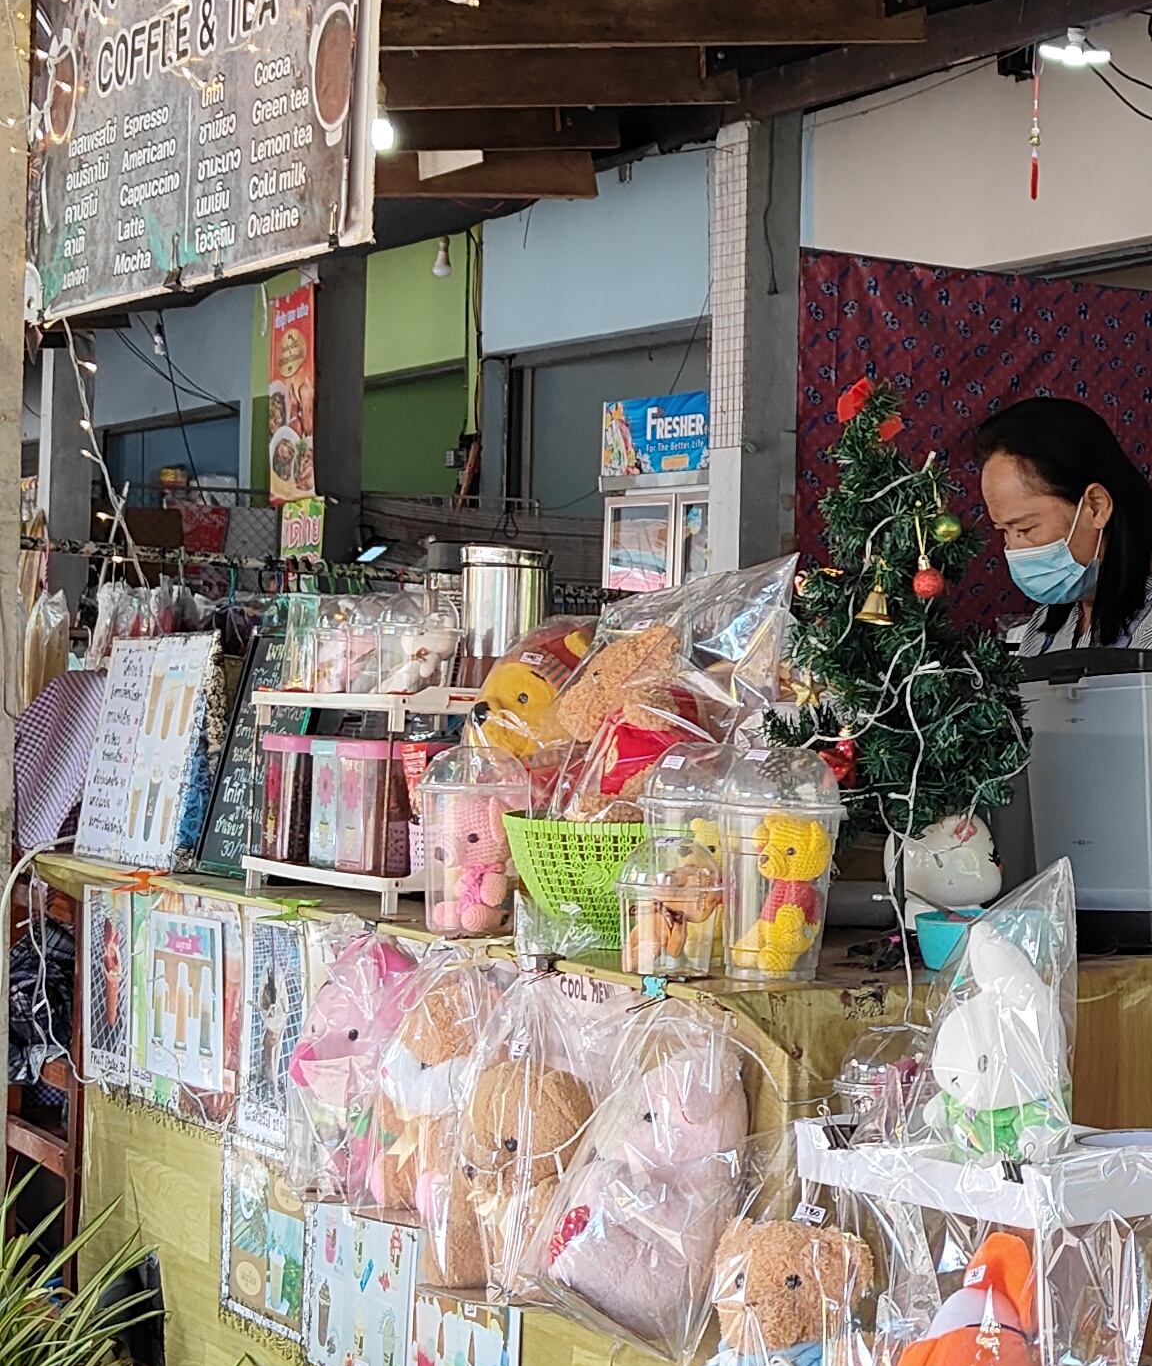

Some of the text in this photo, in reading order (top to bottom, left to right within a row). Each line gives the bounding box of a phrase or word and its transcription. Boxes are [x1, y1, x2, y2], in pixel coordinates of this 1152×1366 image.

[97, 0, 192, 96] COFFEE
[254, 55, 291, 87] Cocoa
[123, 105, 169, 139] Espresso
[252, 86, 309, 125] Green tea
[199, 109, 237, 145] ชาเขียว
[251, 123, 313, 164] Lemon tea
[121, 137, 177, 174] Americano
[197, 146, 242, 181] ชามะนาว
[119, 170, 180, 208] Cappuccino
[196, 179, 230, 218] นมเย็น
[249, 161, 307, 202] Cold milk
[117, 217, 146, 242] Latte
[247, 204, 299, 240] Ovaltine
[113, 248, 151, 277] Mocha
[646, 407, 705, 441] FRESHER
[657, 442, 669, 452] The
[670, 440, 690, 452] Better
[560, 975, 587, 1001] COOL
